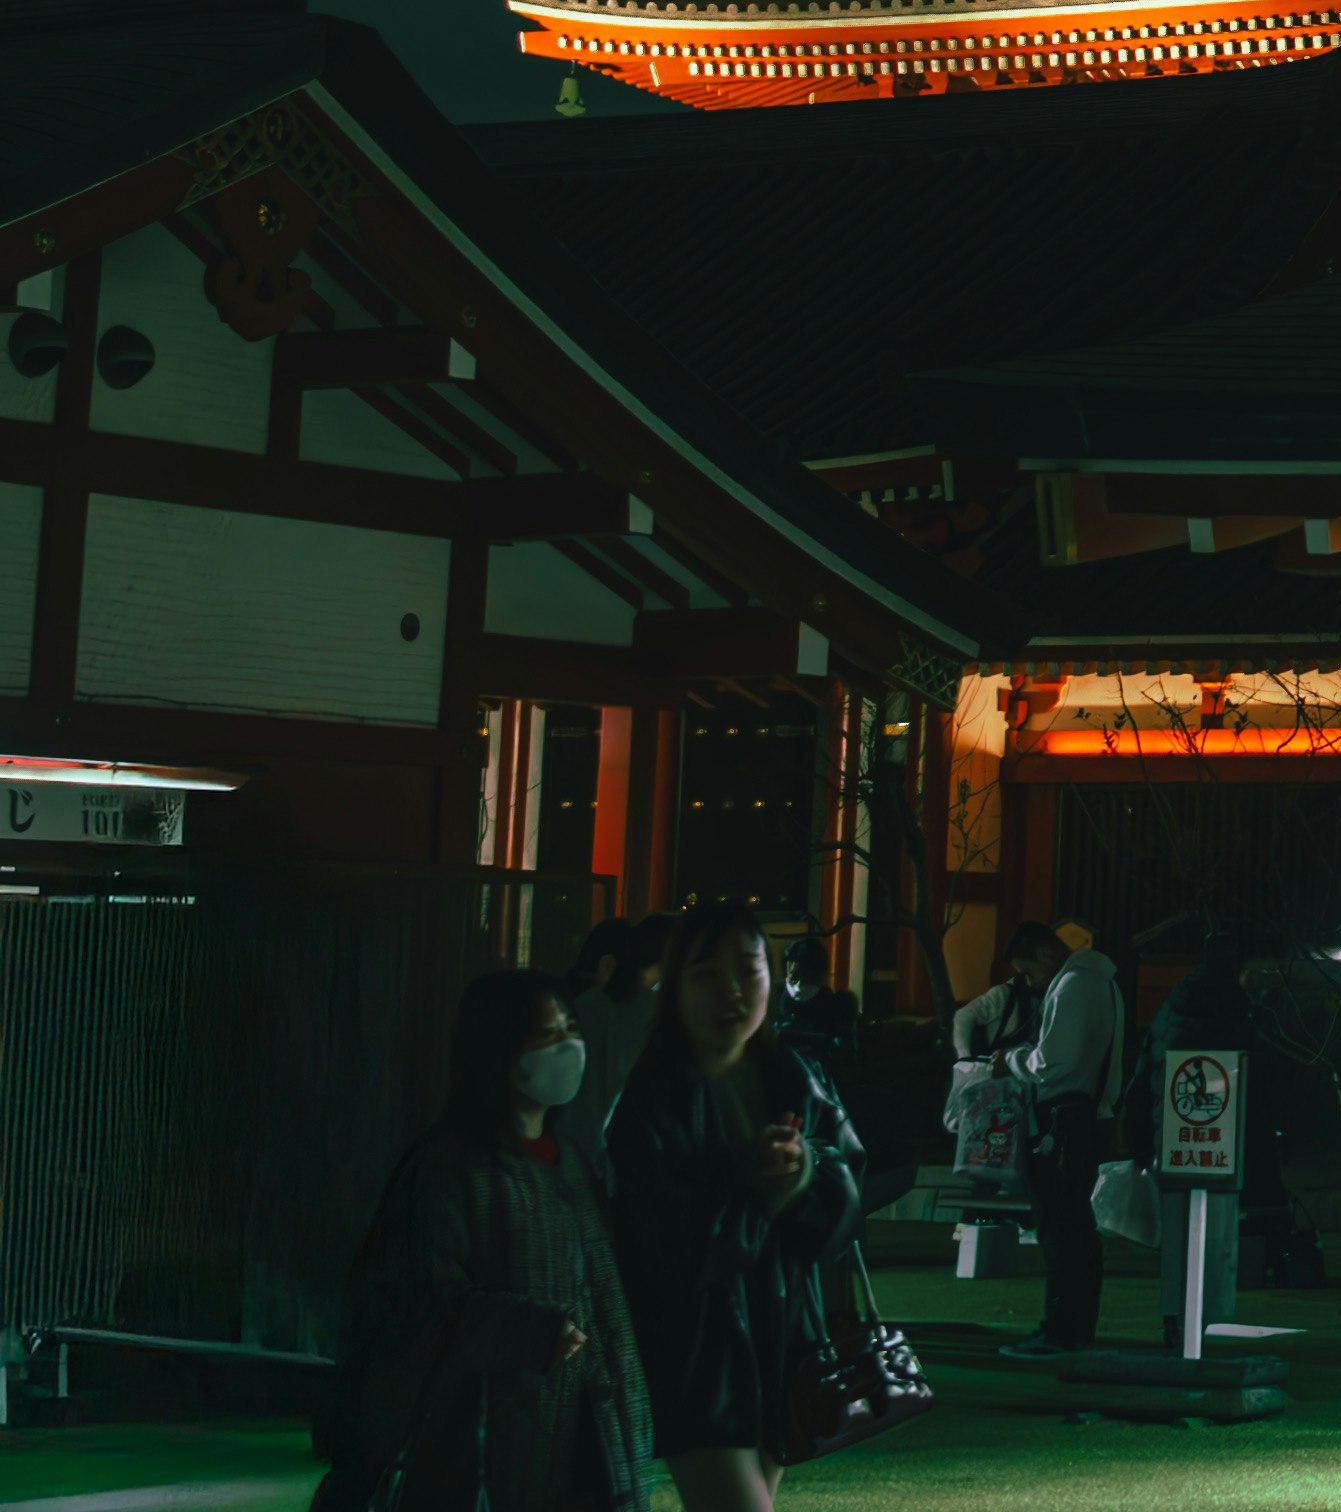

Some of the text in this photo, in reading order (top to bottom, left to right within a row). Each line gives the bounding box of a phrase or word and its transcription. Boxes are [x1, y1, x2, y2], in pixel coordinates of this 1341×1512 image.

[8, 788, 37, 834] じ
[1178, 1126, 1222, 1144] 自転車
[1169, 1150, 1229, 1167] 進入禁止
